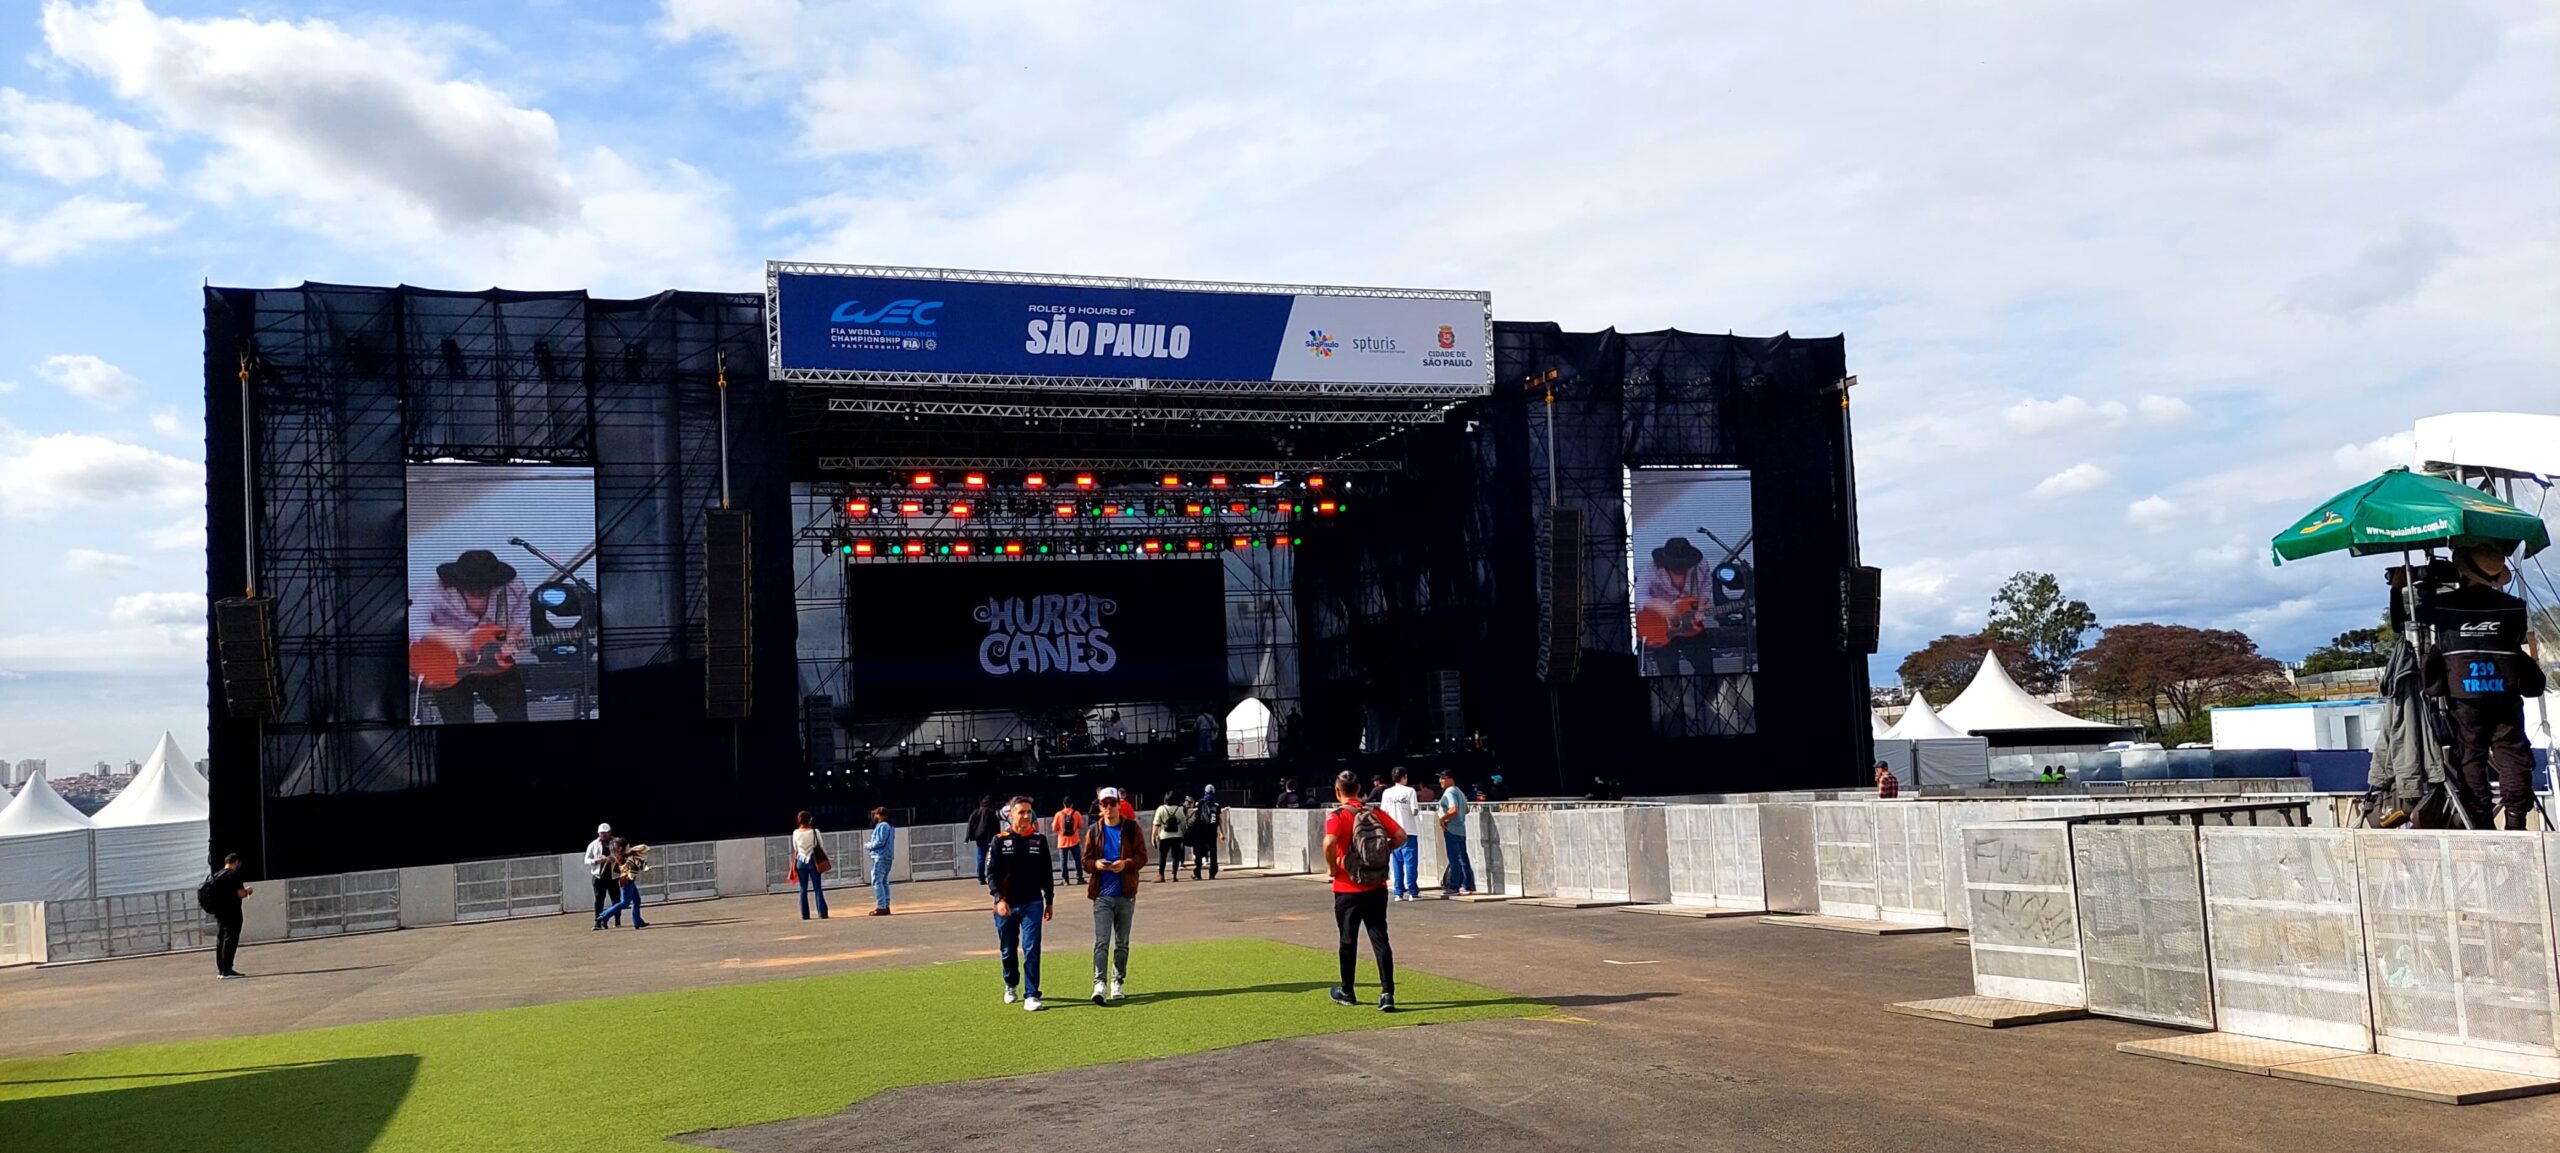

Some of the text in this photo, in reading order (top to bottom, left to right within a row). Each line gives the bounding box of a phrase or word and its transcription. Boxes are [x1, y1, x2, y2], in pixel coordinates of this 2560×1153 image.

[831, 299, 944, 325] WEC
[1028, 305, 1136, 316] ROLEX 6 HOURS OF
[848, 328, 881, 336] WORLD
[883, 329, 937, 337] ENDURANCE
[1025, 314, 1191, 359] SÃO PAULO
[831, 335, 901, 344] CHAMPIONSHIP
[903, 339, 917, 349] FIA
[1352, 336, 1396, 352] spturis
[1428, 350, 1455, 358] CIDADE
[1422, 358, 1473, 367] SÃO PAULO
[2366, 518, 2448, 538] www.aguiainfra.com.br
[973, 593, 1117, 635] HURRI
[2460, 621, 2501, 631] WEC
[979, 628, 1117, 675] CANES
[2469, 662, 2495, 677] 239
[2462, 679, 2504, 692] TRACK
